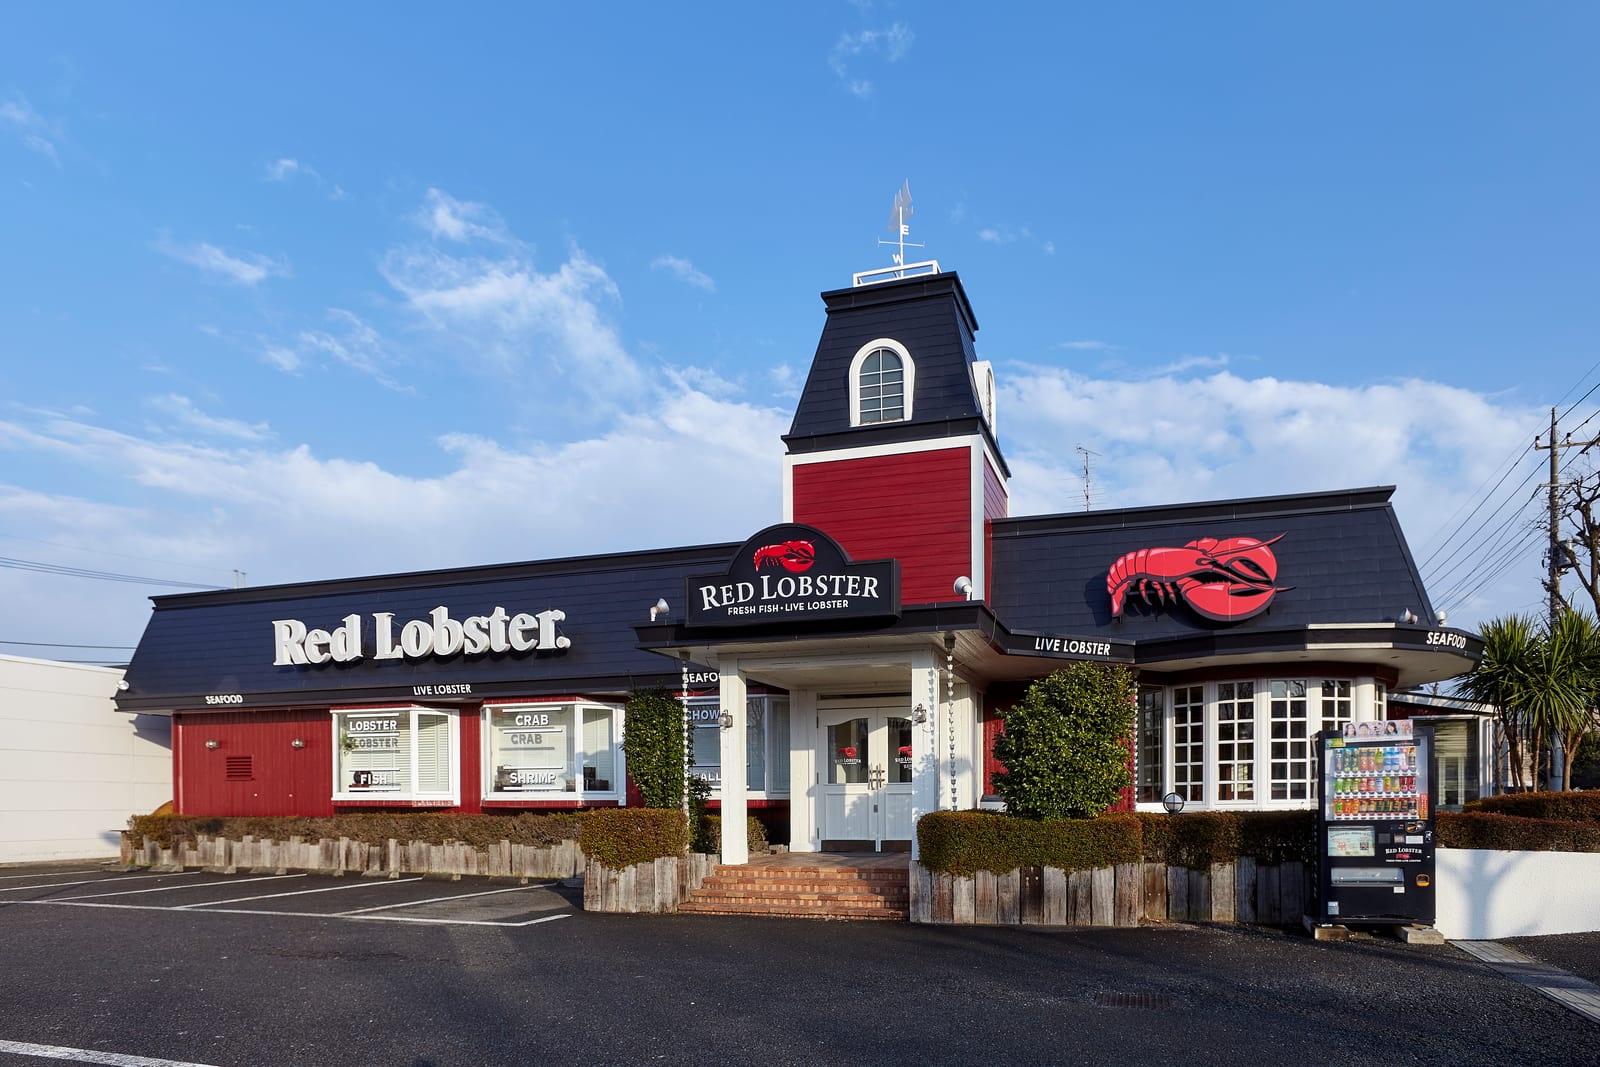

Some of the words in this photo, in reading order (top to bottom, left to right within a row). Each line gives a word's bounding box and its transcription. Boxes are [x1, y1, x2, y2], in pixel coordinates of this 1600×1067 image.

[699, 581, 755, 611] RED
[760, 575, 879, 600] LOBSTER
[727, 606, 756, 616] FRESH
[758, 605, 779, 613] FISH
[785, 602, 804, 612] LIVE
[807, 600, 849, 611] LOBSTER
[272, 614, 363, 666] Red
[1034, 637, 1060, 652] LIVE
[1063, 640, 1111, 655] LOBSTER
[1426, 632, 1467, 649] SEAFOOD
[413, 685, 433, 695] LIVE
[434, 683, 472, 695] LOBSTER
[205, 694, 243, 705] SEAFOOD
[349, 720, 398, 731] LOBSTER
[515, 714, 549, 726] CRAB
[510, 733, 543, 745] CRAB
[360, 773, 388, 785] FISH
[509, 772, 557, 784] SHRIMP
